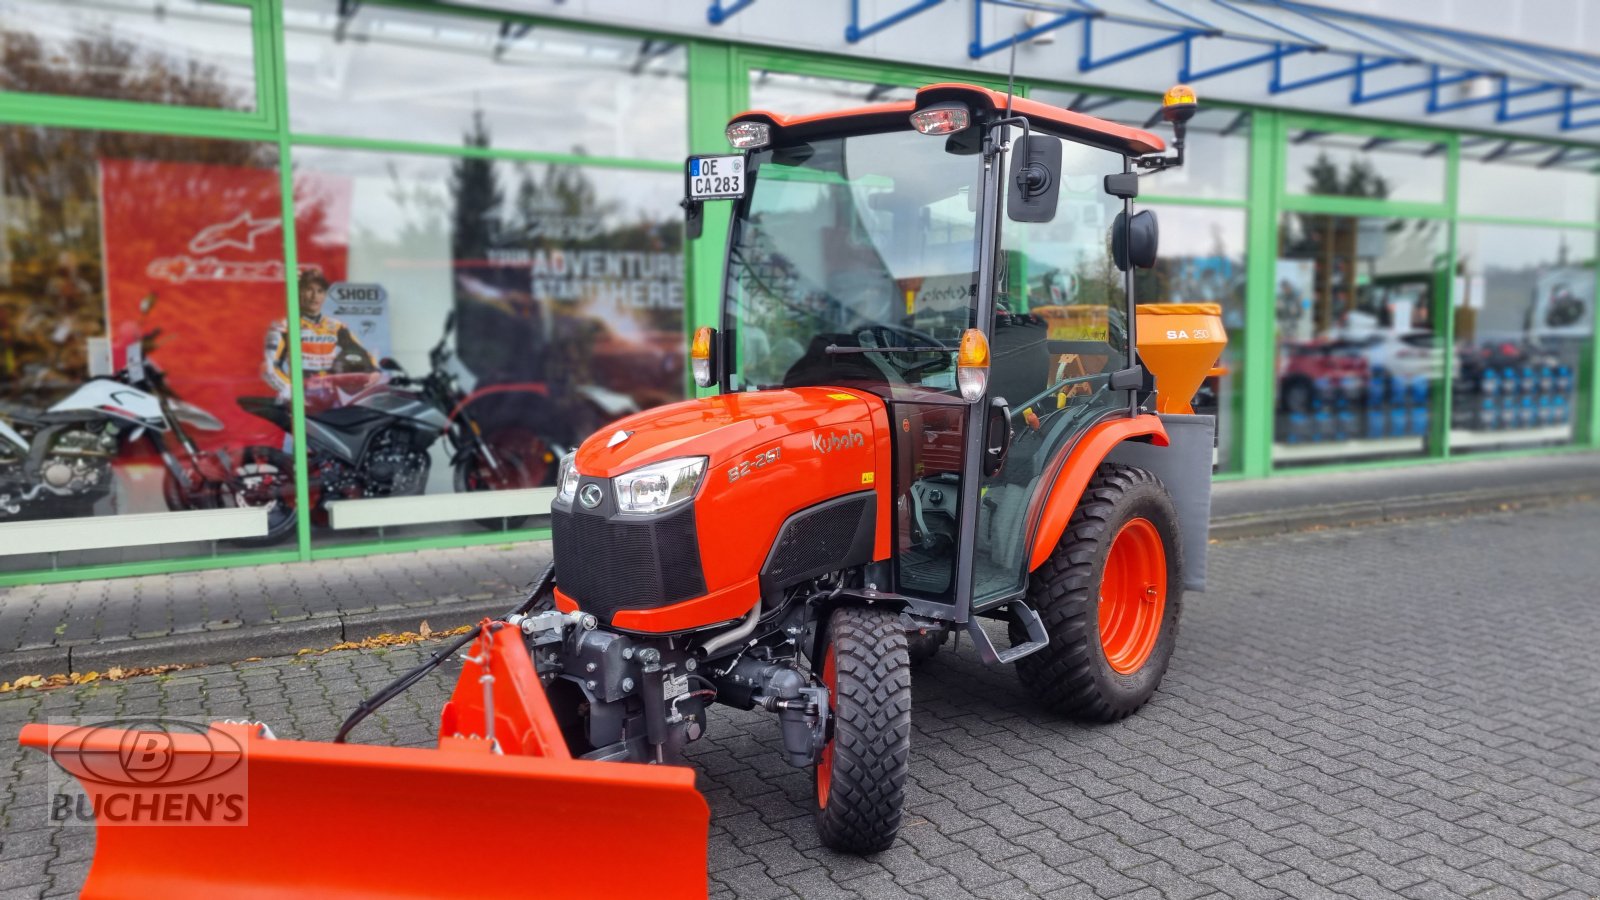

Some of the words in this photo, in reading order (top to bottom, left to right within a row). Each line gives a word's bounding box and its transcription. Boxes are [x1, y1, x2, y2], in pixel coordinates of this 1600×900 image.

[702, 160, 718, 176] OE
[337, 288, 379, 301] SHOEI
[1166, 330, 1189, 340] SA
[811, 429, 864, 454] Kubota
[727, 446, 781, 483] B2-261
